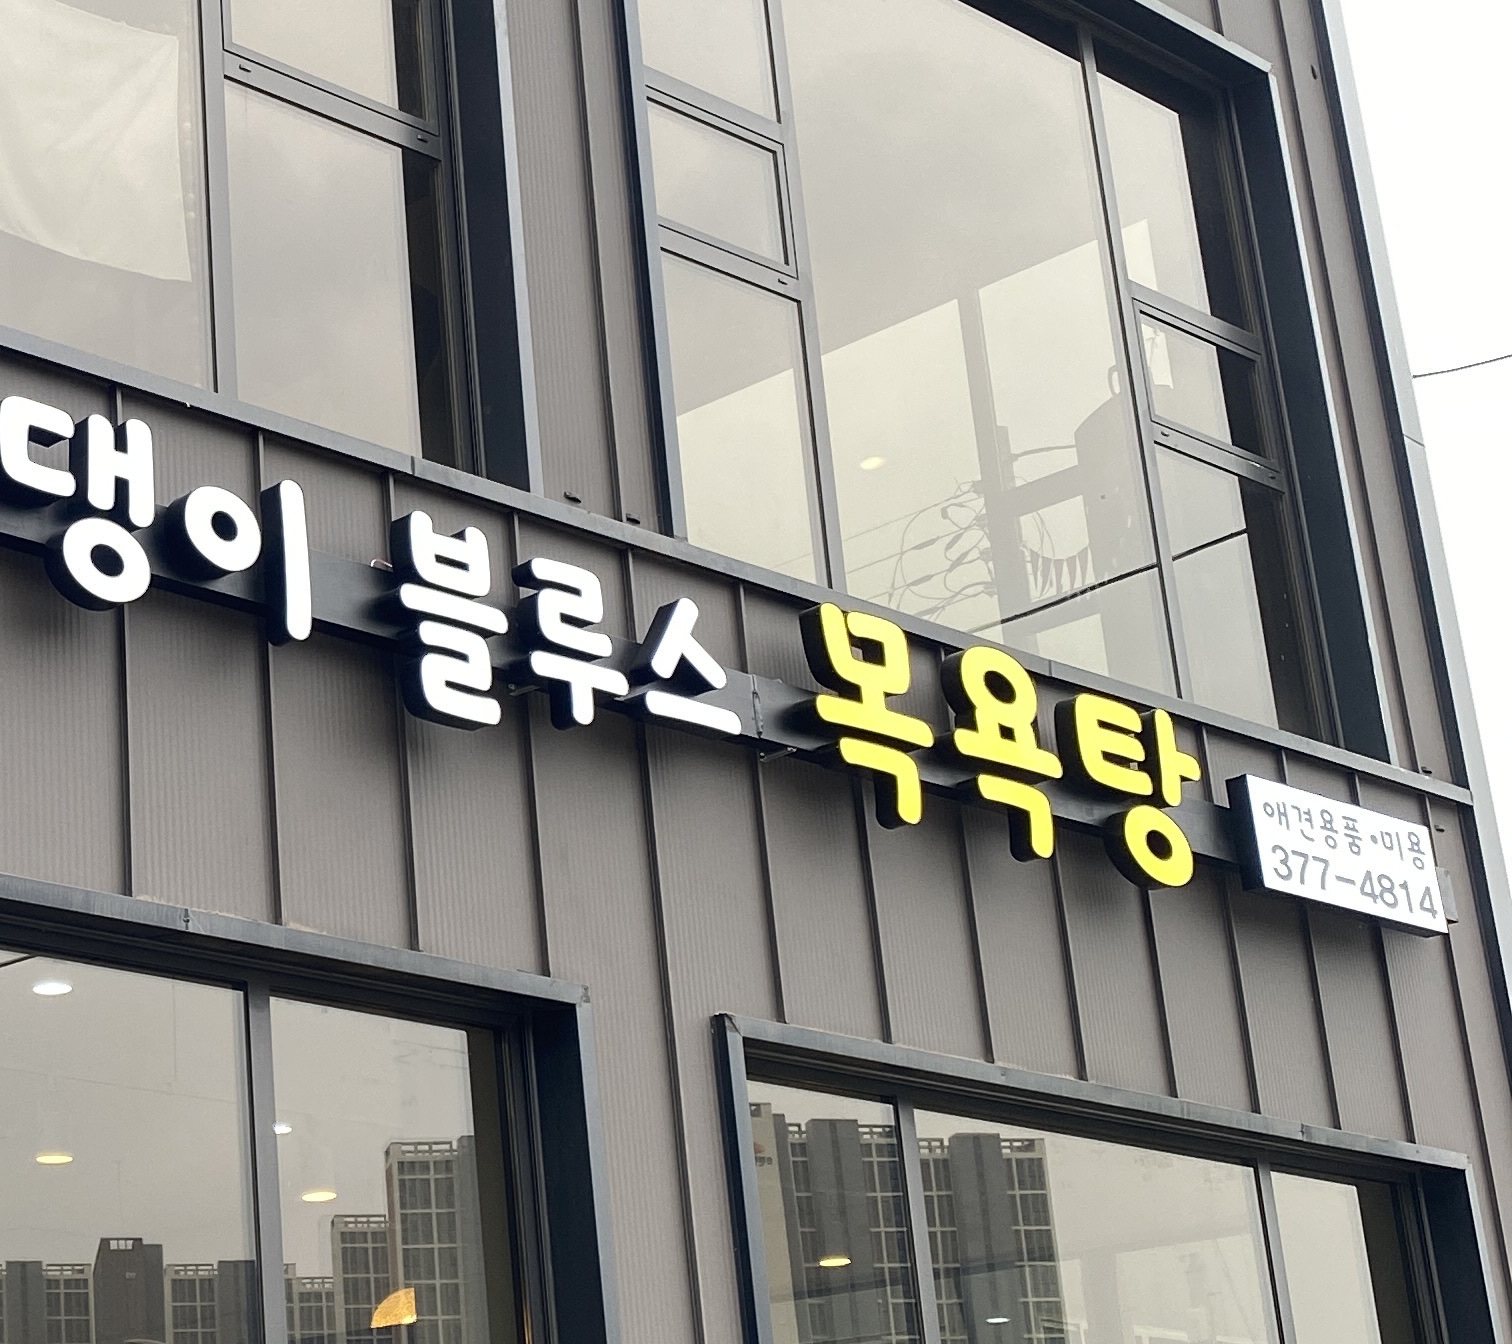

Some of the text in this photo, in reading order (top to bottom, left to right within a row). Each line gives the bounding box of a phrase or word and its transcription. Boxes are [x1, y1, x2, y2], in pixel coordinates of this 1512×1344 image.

[399, 509, 743, 736] 블루스
[816, 602, 1201, 889] 목욕탕
[1271, 843, 1439, 920] 377-4814
